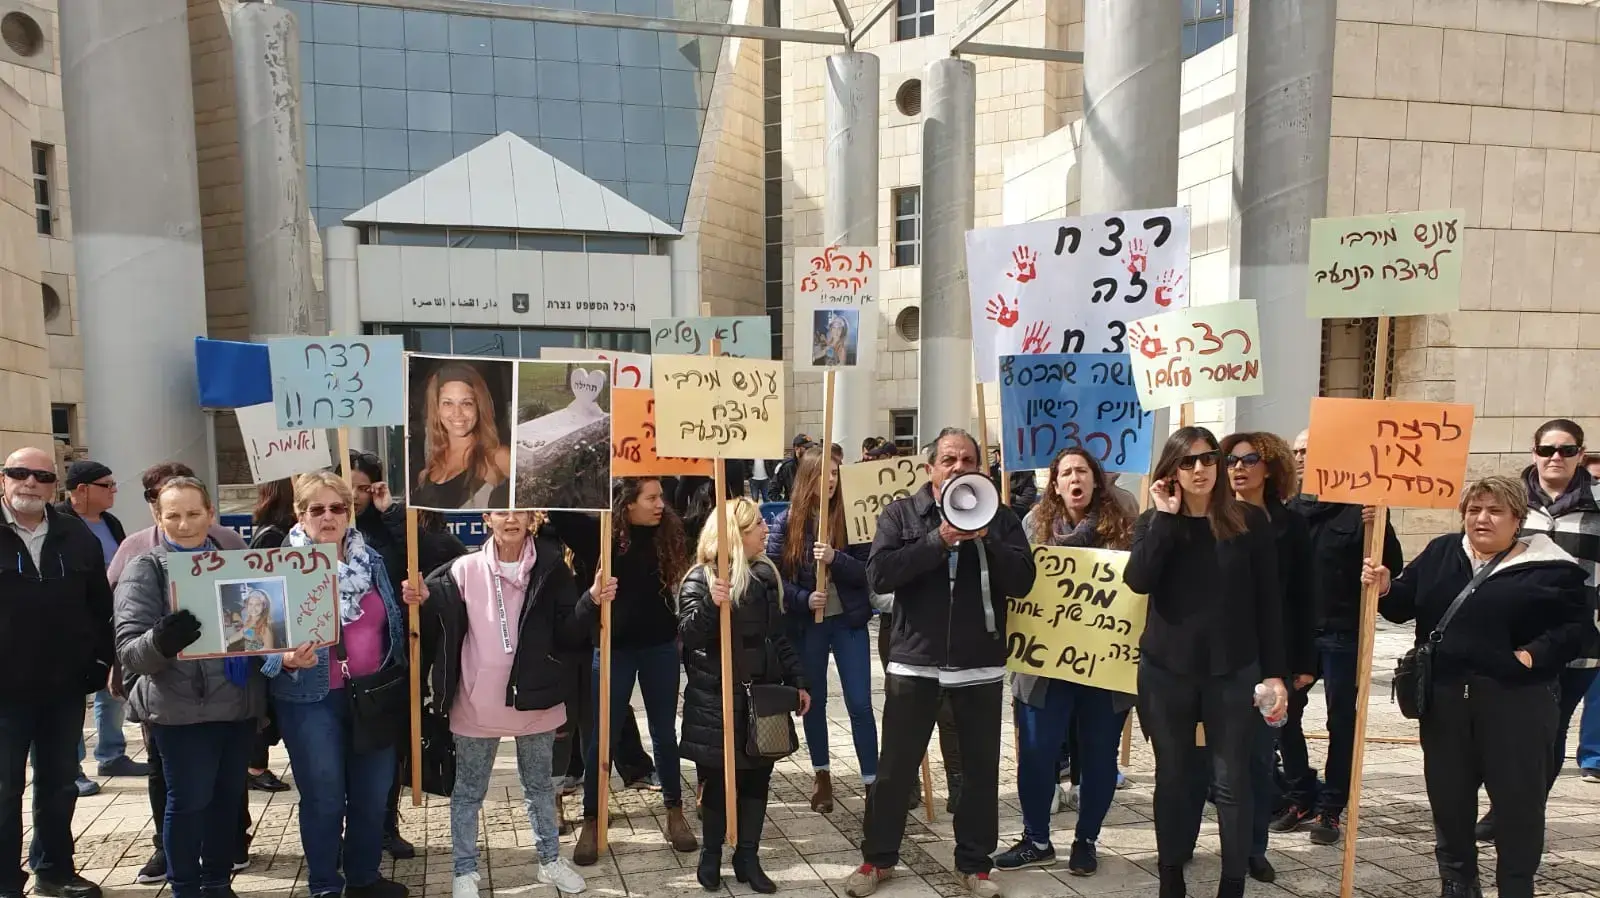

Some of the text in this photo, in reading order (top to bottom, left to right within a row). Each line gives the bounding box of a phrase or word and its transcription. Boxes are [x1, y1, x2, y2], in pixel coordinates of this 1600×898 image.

[1054, 215, 1173, 257] רצח
[1339, 219, 1458, 249] עונש מירבי
[810, 244, 872, 272] תהילה
[1314, 249, 1452, 291] לרוצח הנתעב
[826, 276, 868, 295] יקרה
[860, 294, 875, 305] אין
[1091, 271, 1148, 304] זה
[412, 297, 498, 309] دار القضاء الناصرة
[547, 300, 636, 312] היכל המשפט נצרת
[715, 320, 744, 344] לא
[1175, 322, 1252, 355] רצח
[305, 343, 371, 370] רצח
[1200, 359, 1259, 382] מאסר
[574, 380, 598, 392] תהילה
[664, 369, 777, 397] עונש מירבי
[1091, 361, 1134, 386] ושה
[712, 394, 779, 422] לרוצח
[1026, 399, 1078, 425] רישיון
[679, 419, 747, 446] הנתעב
[1377, 410, 1462, 441] לרצח
[1370, 443, 1423, 476] אין
[1316, 468, 1372, 496] טיעון
[243, 547, 331, 575] תהילה
[1092, 562, 1115, 582] זו
[1057, 578, 1118, 608] מחר
[1085, 613, 1131, 635] הבת
[1056, 646, 1096, 678] וגם
